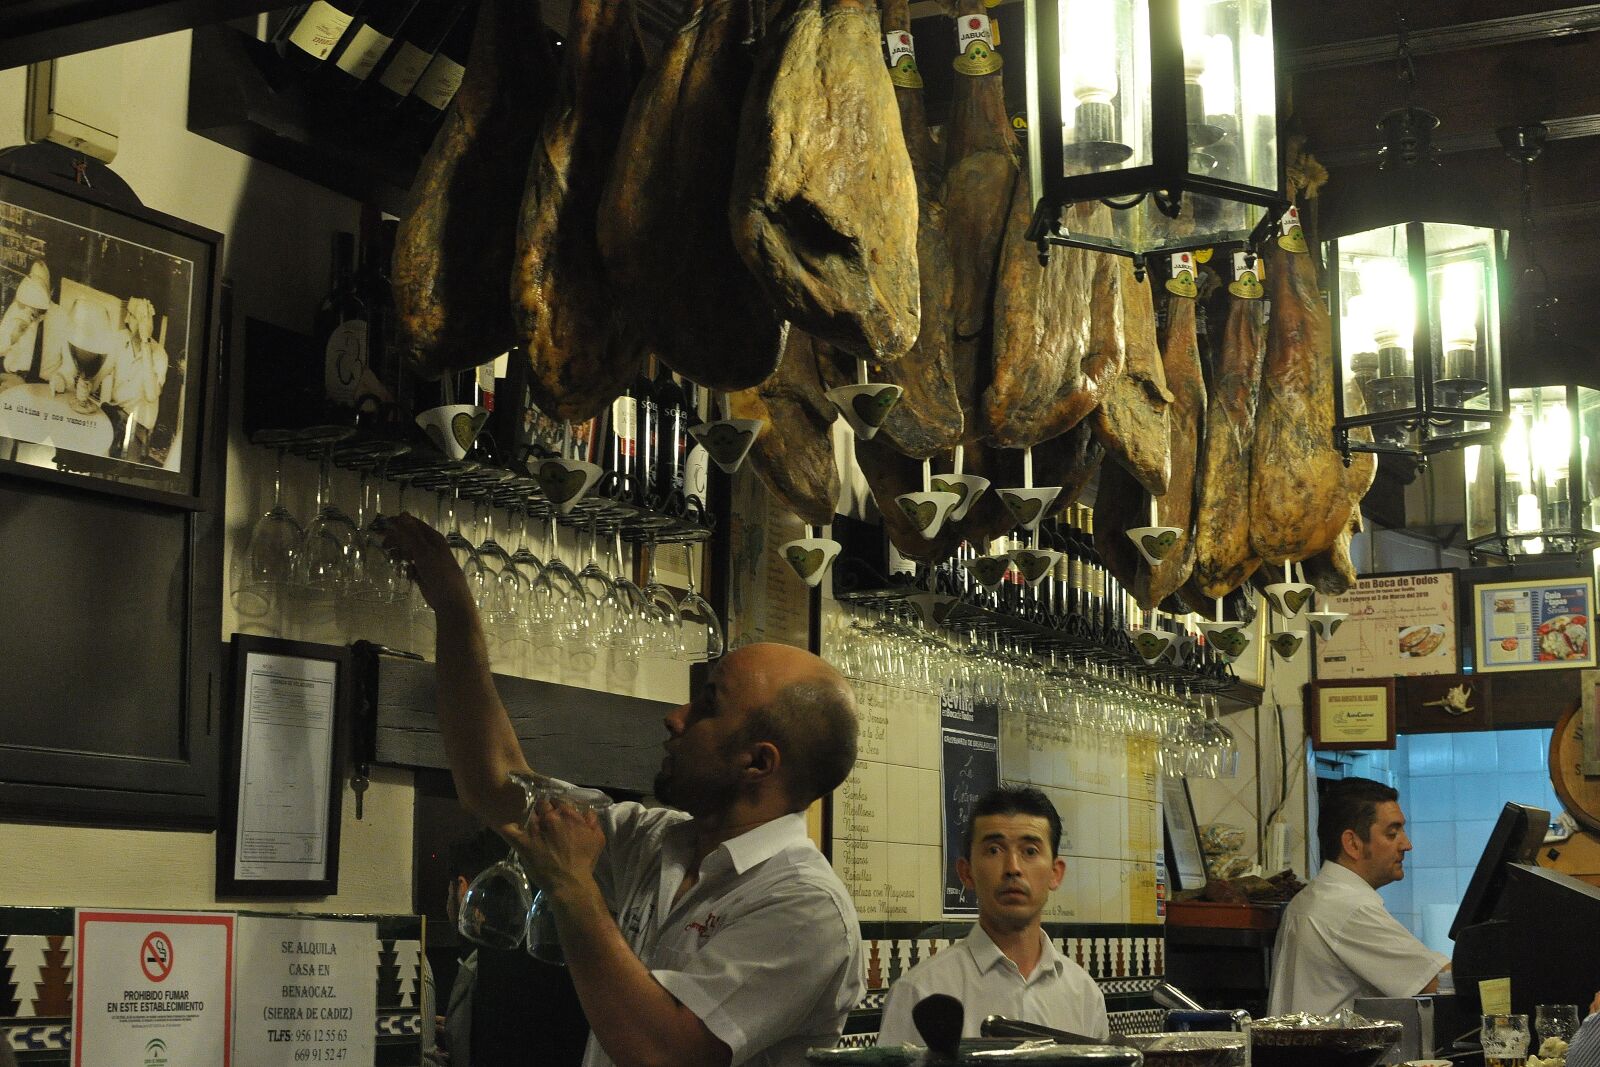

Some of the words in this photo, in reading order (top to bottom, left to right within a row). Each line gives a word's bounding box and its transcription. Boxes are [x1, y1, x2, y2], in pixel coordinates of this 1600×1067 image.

[1360, 580, 1371, 590] en
[1373, 578, 1396, 589] Boca
[1397, 577, 1409, 587] de
[1411, 575, 1439, 586] Todos
[282, 941, 294, 954] SE
[297, 941, 337, 955] ALQUILA
[289, 963, 315, 976] CASA
[318, 964, 330, 976] EN
[124, 990, 163, 1000] PROHIBIDO
[164, 990, 189, 1000] FUMAR
[282, 985, 336, 998] BENAOCAZ.
[107, 1002, 118, 1013] EN
[120, 1002, 138, 1012] ESTE
[140, 1001, 204, 1013] ESTABLECIMIENTO
[263, 1006, 303, 1021] (SIERRA
[306, 1007, 318, 1020] DE
[296, 1029, 311, 1042] 956
[314, 1029, 324, 1042] 12
[325, 1029, 336, 1042] 55
[337, 1029, 348, 1042] 63
[294, 1048, 311, 1061] 669
[312, 1048, 322, 1061] 91
[324, 1048, 335, 1061] 52
[336, 1048, 347, 1061] 47
